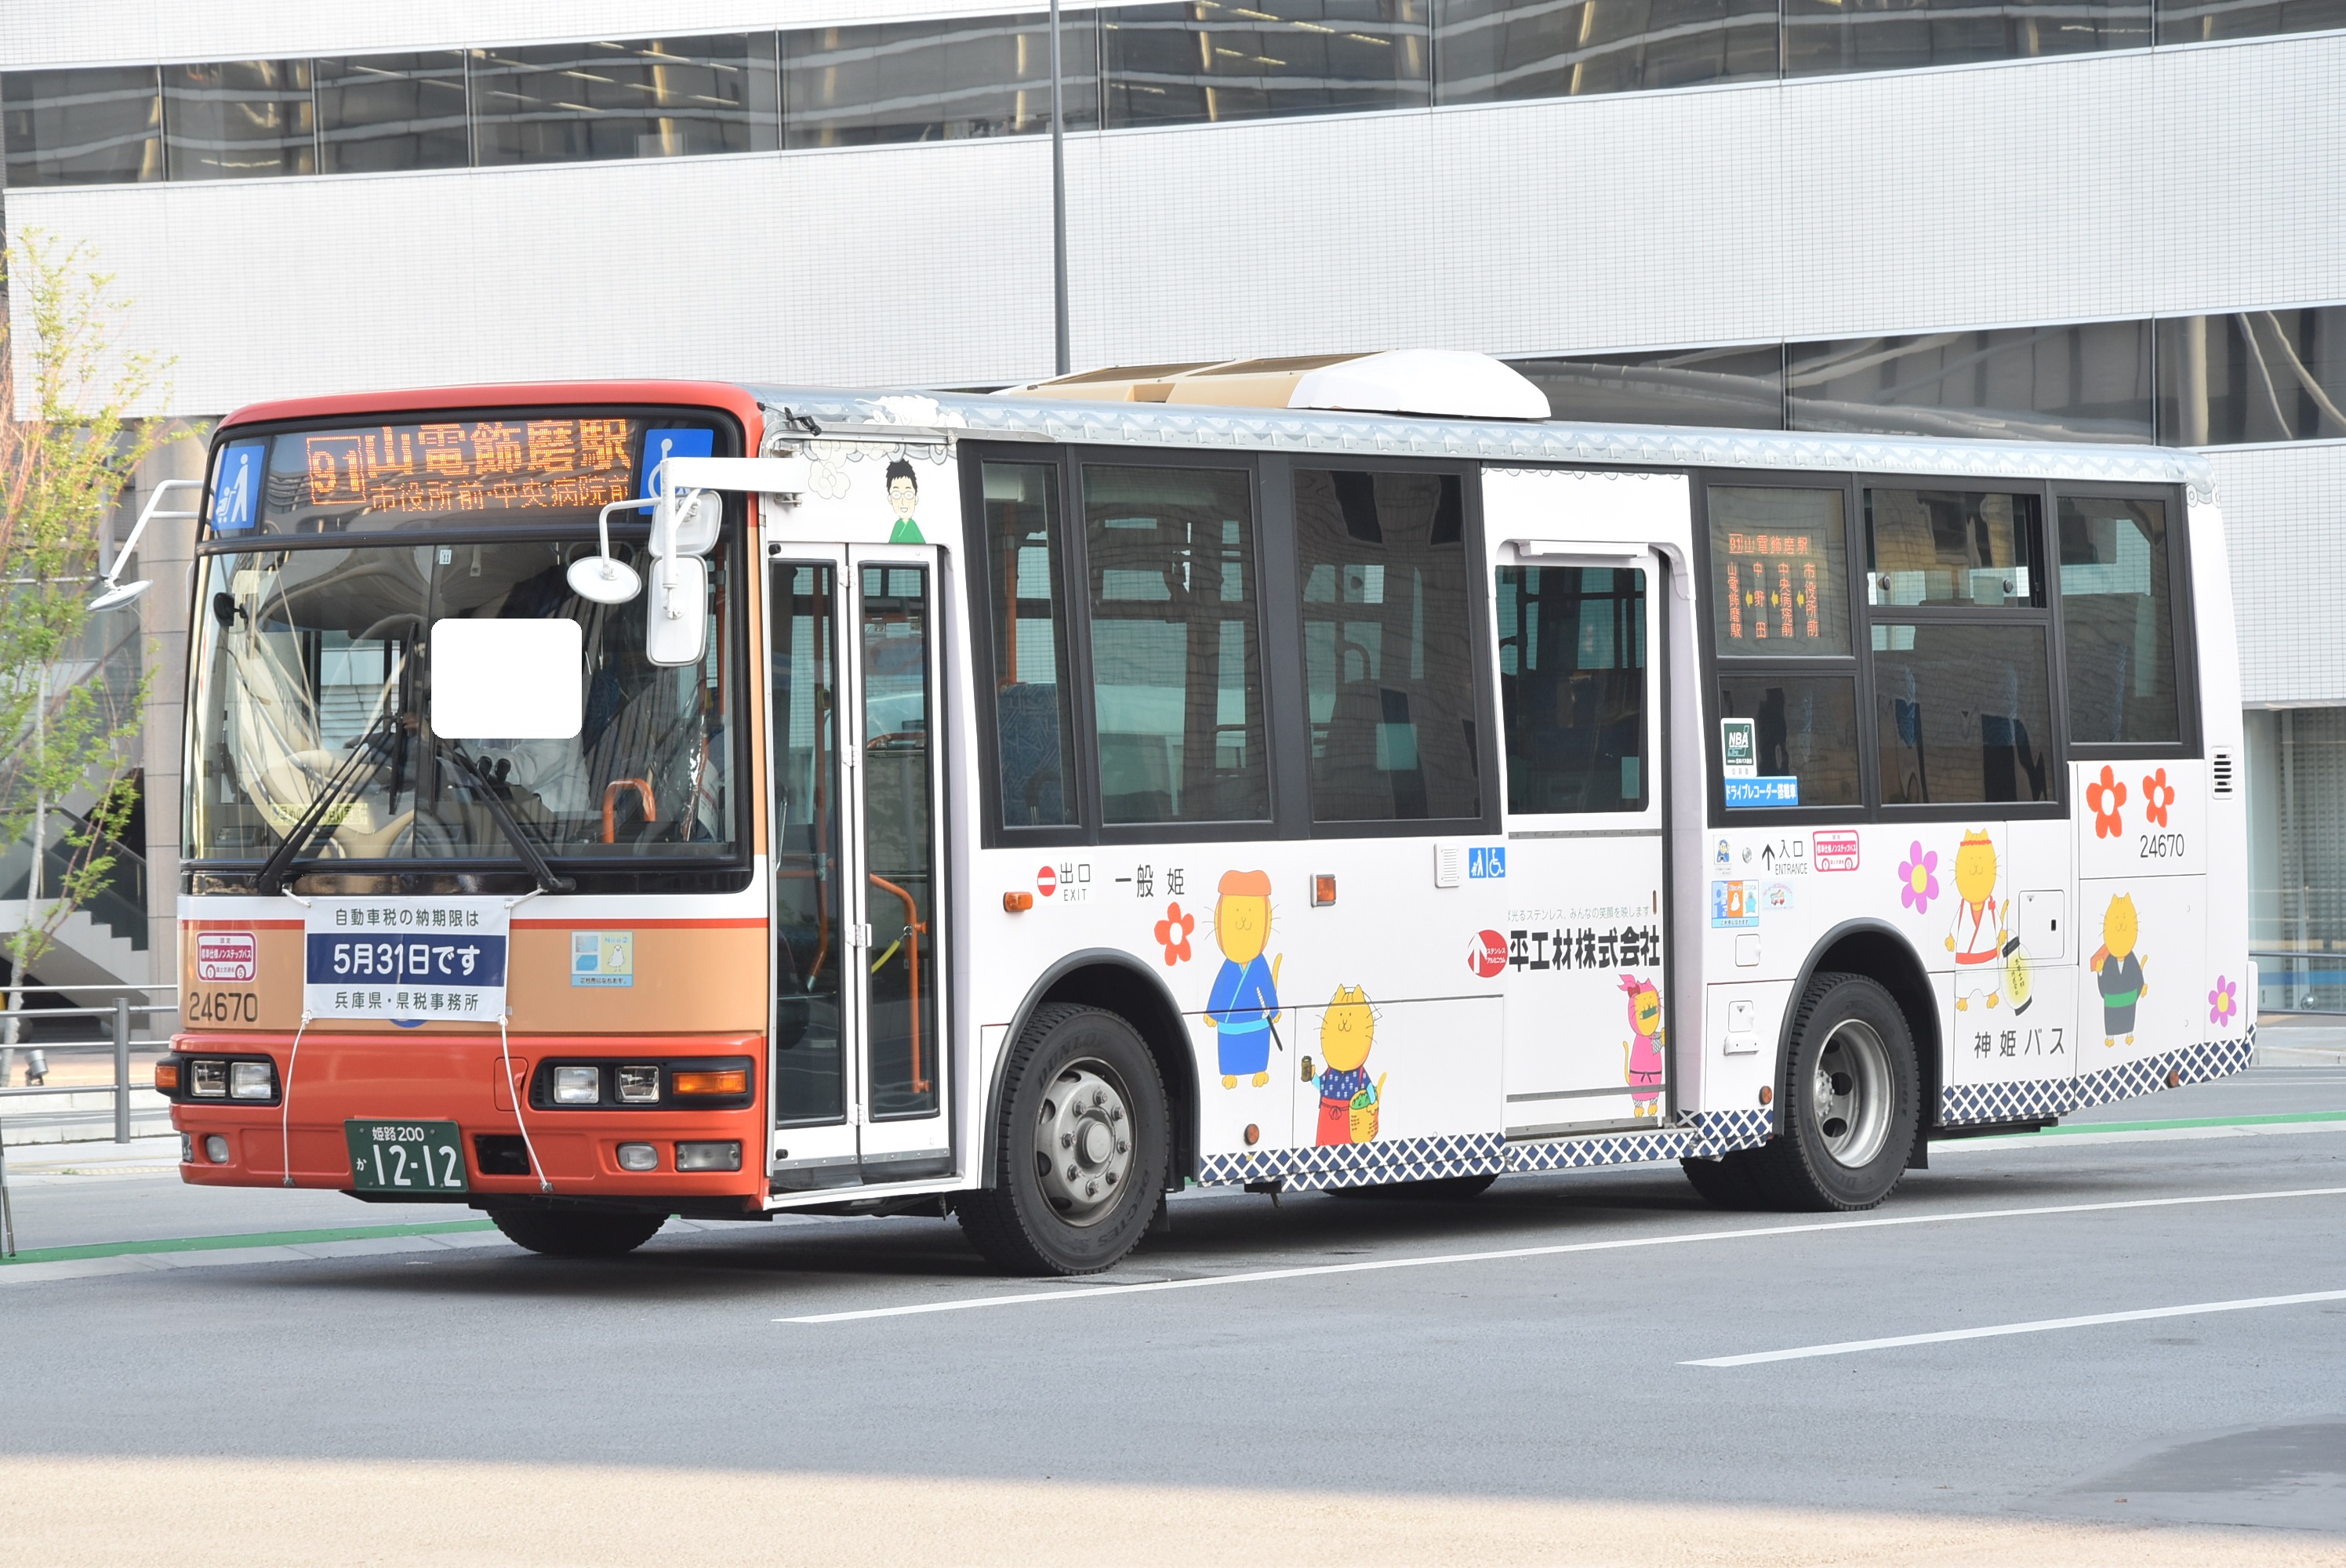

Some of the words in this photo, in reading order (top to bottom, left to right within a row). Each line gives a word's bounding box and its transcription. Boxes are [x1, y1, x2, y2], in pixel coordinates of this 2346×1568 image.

[365, 419, 630, 478] 山電飾磨駅
[312, 449, 360, 492] 91
[1744, 535, 1808, 554] 山電飾磨駅
[1727, 561, 1741, 637] 山電飾磨駅
[1778, 562, 1793, 637] 中央病院前
[1803, 562, 1818, 637] 市役所前
[1728, 731, 1749, 746] NBA
[1726, 782, 1797, 800] ドライブレコーダー搭載車
[1778, 839, 1803, 858] 入口
[2140, 833, 2185, 858] 24670
[1060, 862, 1091, 884] 出口
[1775, 863, 1808, 875] ENTRANCE
[1063, 888, 1087, 902] EXIT
[335, 908, 480, 928] 自動車税の納期限は
[333, 942, 481, 976] 5月31日です
[1509, 924, 1660, 972] 平工材株式会社
[189, 992, 258, 1022] 24670
[334, 993, 479, 1012] 兵庫県・県税事務所
[1974, 1028, 2065, 1059] 神姫バス
[357, 1157, 368, 1171] か
[372, 1144, 463, 1188] 12-12
